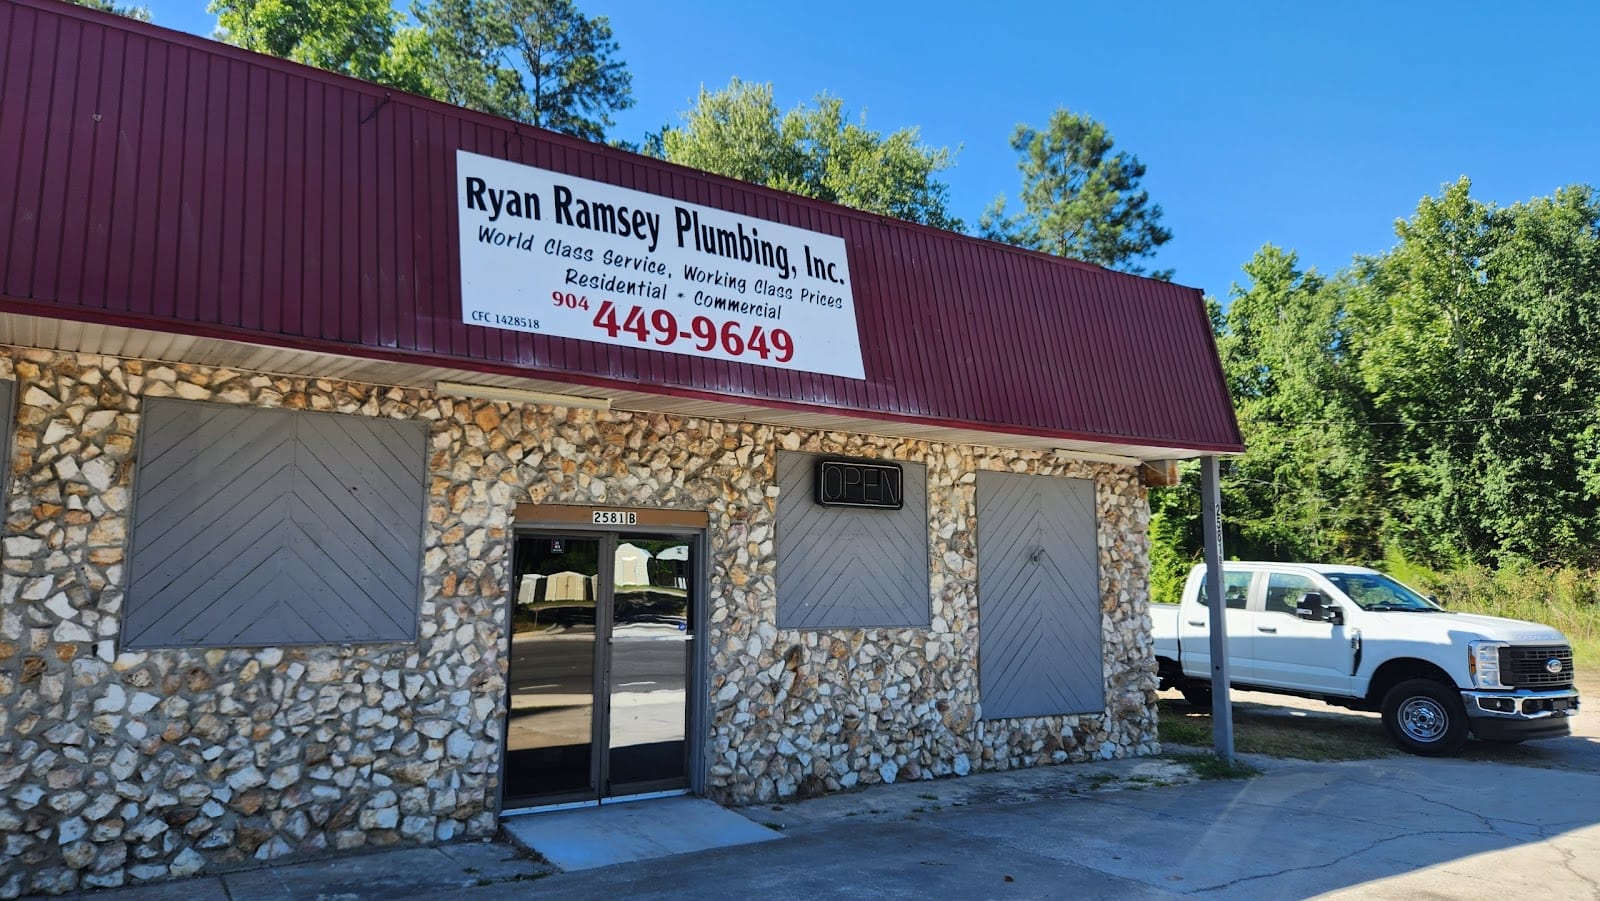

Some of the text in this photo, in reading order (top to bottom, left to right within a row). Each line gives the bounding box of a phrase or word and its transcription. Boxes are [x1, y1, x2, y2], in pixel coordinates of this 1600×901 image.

[465, 176, 845, 285] Ryan Ramsey Plumbing, Inc.
[478, 225, 534, 251] World
[544, 238, 593, 261] Class
[684, 264, 746, 294] Working
[754, 279, 793, 300] Class
[800, 288, 842, 309] Prices
[565, 268, 782, 320] Residential Commercial
[471, 310, 540, 329] CFC 1428518
[552, 291, 794, 363] 904 449-9649
[824, 466, 898, 503] OPEN
